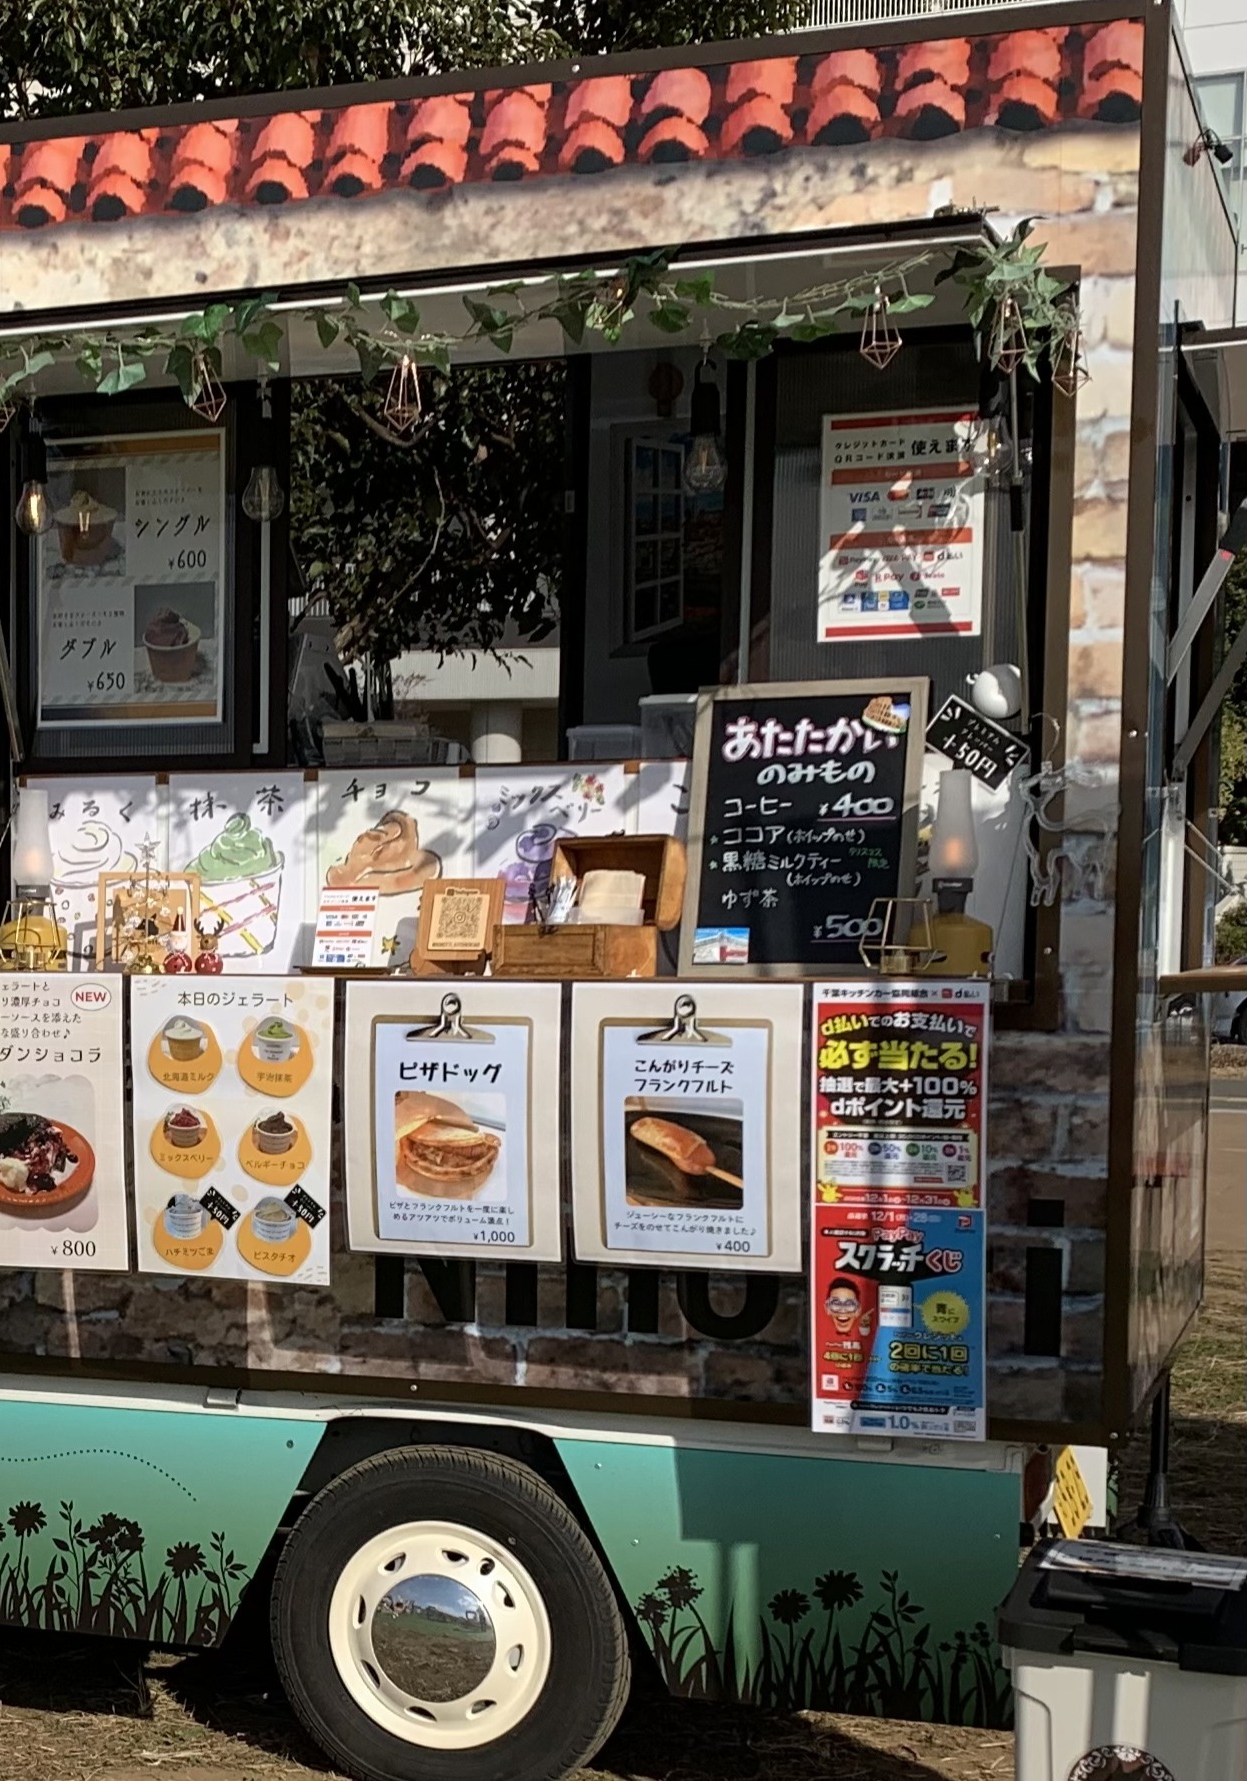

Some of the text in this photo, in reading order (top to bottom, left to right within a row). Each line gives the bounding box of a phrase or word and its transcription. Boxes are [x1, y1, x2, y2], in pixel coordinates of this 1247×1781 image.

[849, 490, 881, 503] VISA
[135, 514, 211, 538] シングル
[168, 549, 207, 570] ¥600
[60, 637, 117, 660] ダブル
[87, 671, 125, 692] ¥650
[721, 715, 900, 761] あたたかい
[942, 733, 998, 779] +50円
[756, 760, 876, 787] のみもの
[340, 777, 432, 802] チョコ
[49, 800, 133, 823] みるく
[190, 784, 285, 821] 抹茶
[723, 796, 793, 818] コーヒー
[818, 792, 895, 818] ¥400
[721, 849, 843, 873] 黒糖ミルクティー
[721, 887, 779, 910] ゆず茶
[812, 914, 884, 940] ¥500
[75, 991, 108, 1002] NEW
[177, 991, 294, 1008] 本日のジェラート
[820, 1010, 978, 1037] d払いでのお支払いで
[819, 1039, 978, 1070] 必ず当たる!
[163, 1071, 215, 1082] 北海道ミルク
[257, 1072, 294, 1083] 宇治抹茶
[399, 1062, 503, 1084] ピザドッグ
[634, 1059, 735, 1075] こんがりチーズ
[633, 1078, 734, 1094] フランクフルト
[830, 1097, 967, 1119] dポイント還元
[158, 1153, 215, 1163] ミックスベリー
[245, 1160, 306, 1170] ベルギーチョコ
[51, 1239, 97, 1258] ¥800
[473, 1231, 516, 1244] ¥1,000
[715, 1240, 752, 1254] ¥400
[254, 1250, 297, 1263] ピスタチオ
[835, 1241, 963, 1273] スクラッチくじ
[889, 1341, 969, 1361] 2回に1回
